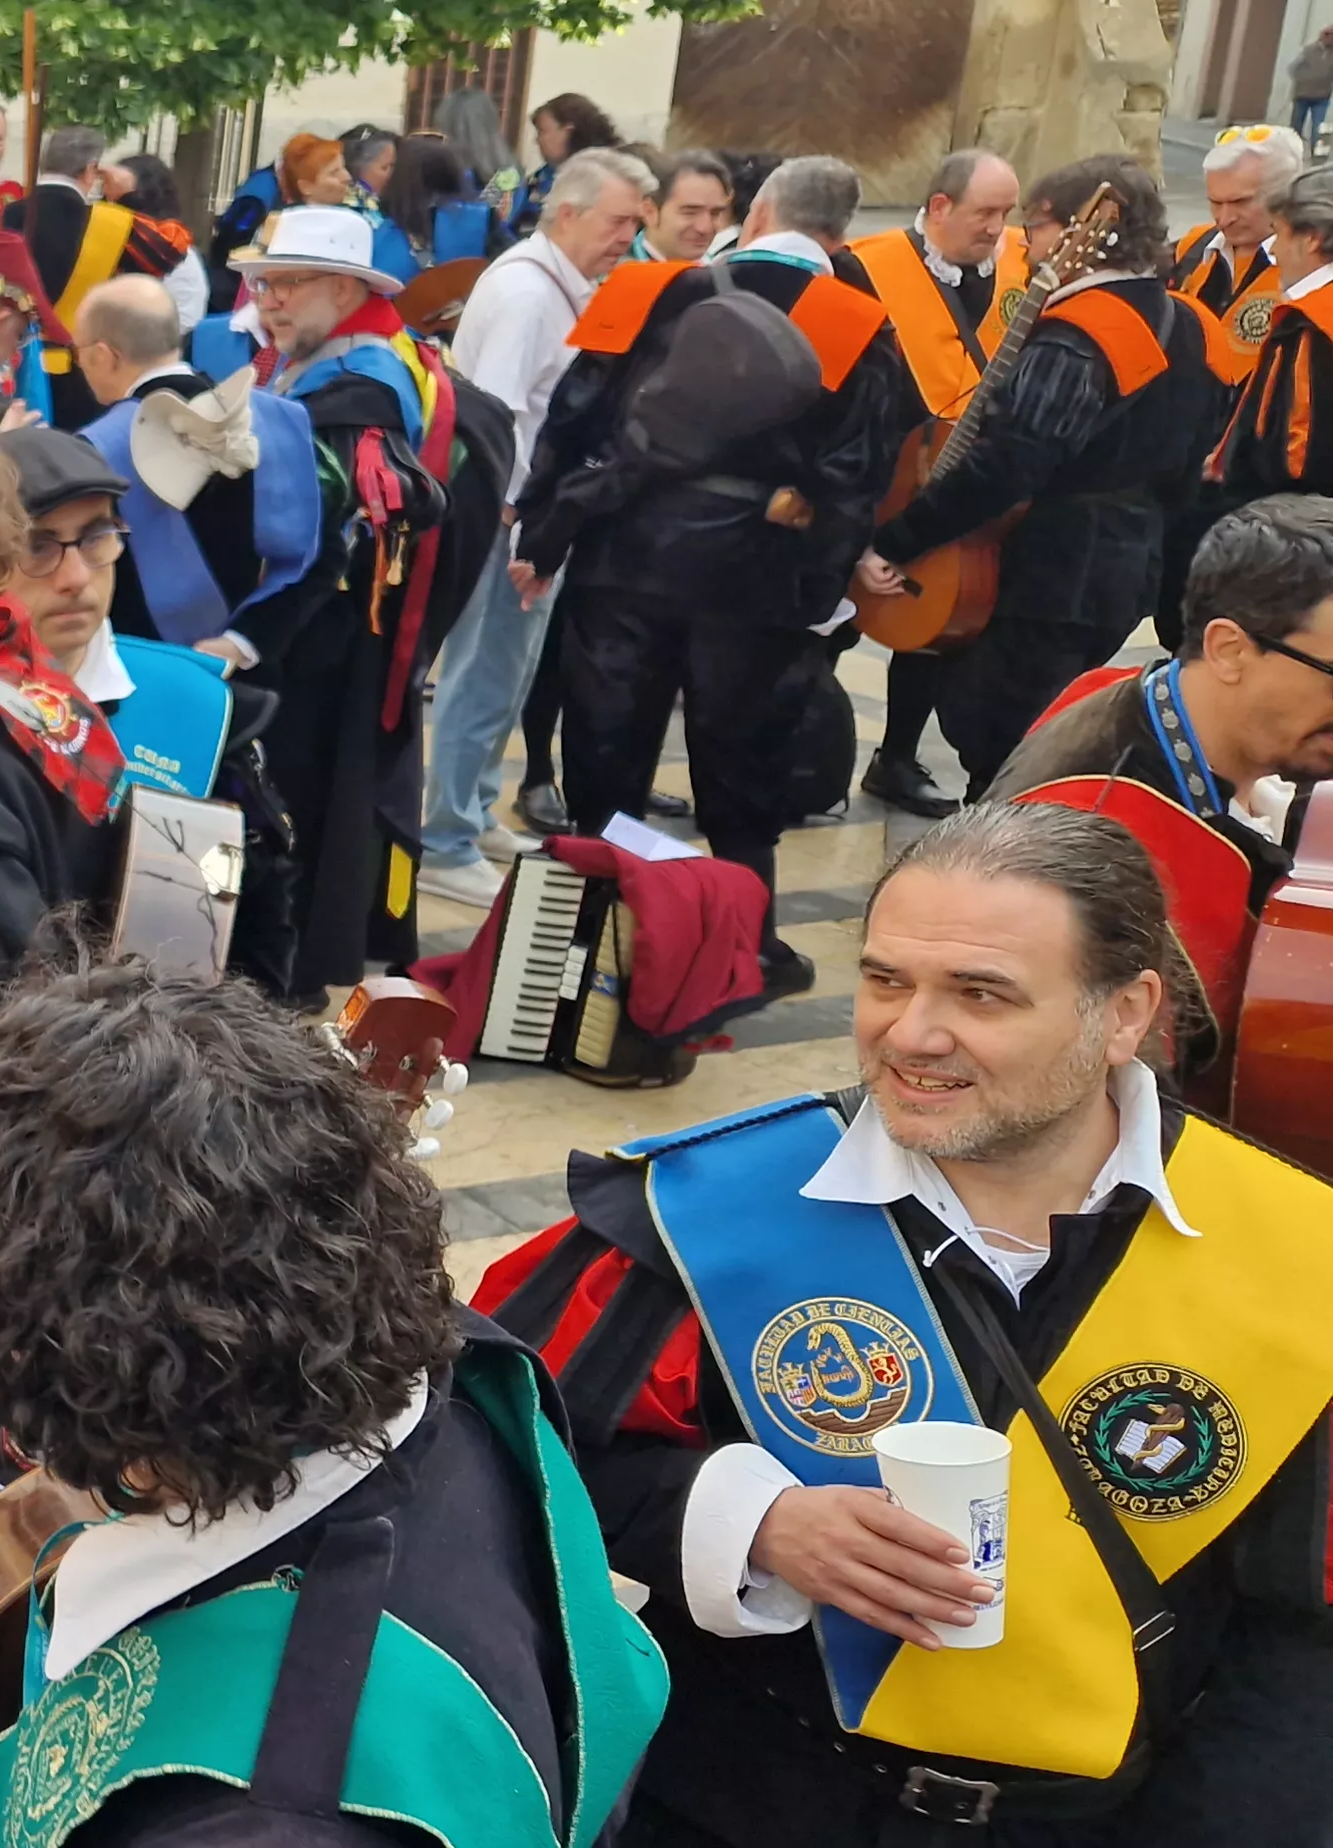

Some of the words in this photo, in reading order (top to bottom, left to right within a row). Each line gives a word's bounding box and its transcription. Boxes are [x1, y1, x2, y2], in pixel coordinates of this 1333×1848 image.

[757, 1309, 807, 1394] FACULTAD
[805, 1303, 831, 1321] DE
[834, 1303, 921, 1361] CIENCIAS
[1175, 1374, 1210, 1400] DE
[1068, 1368, 1171, 1436] FACULTAD
[1189, 1400, 1239, 1503] MEDICINA
